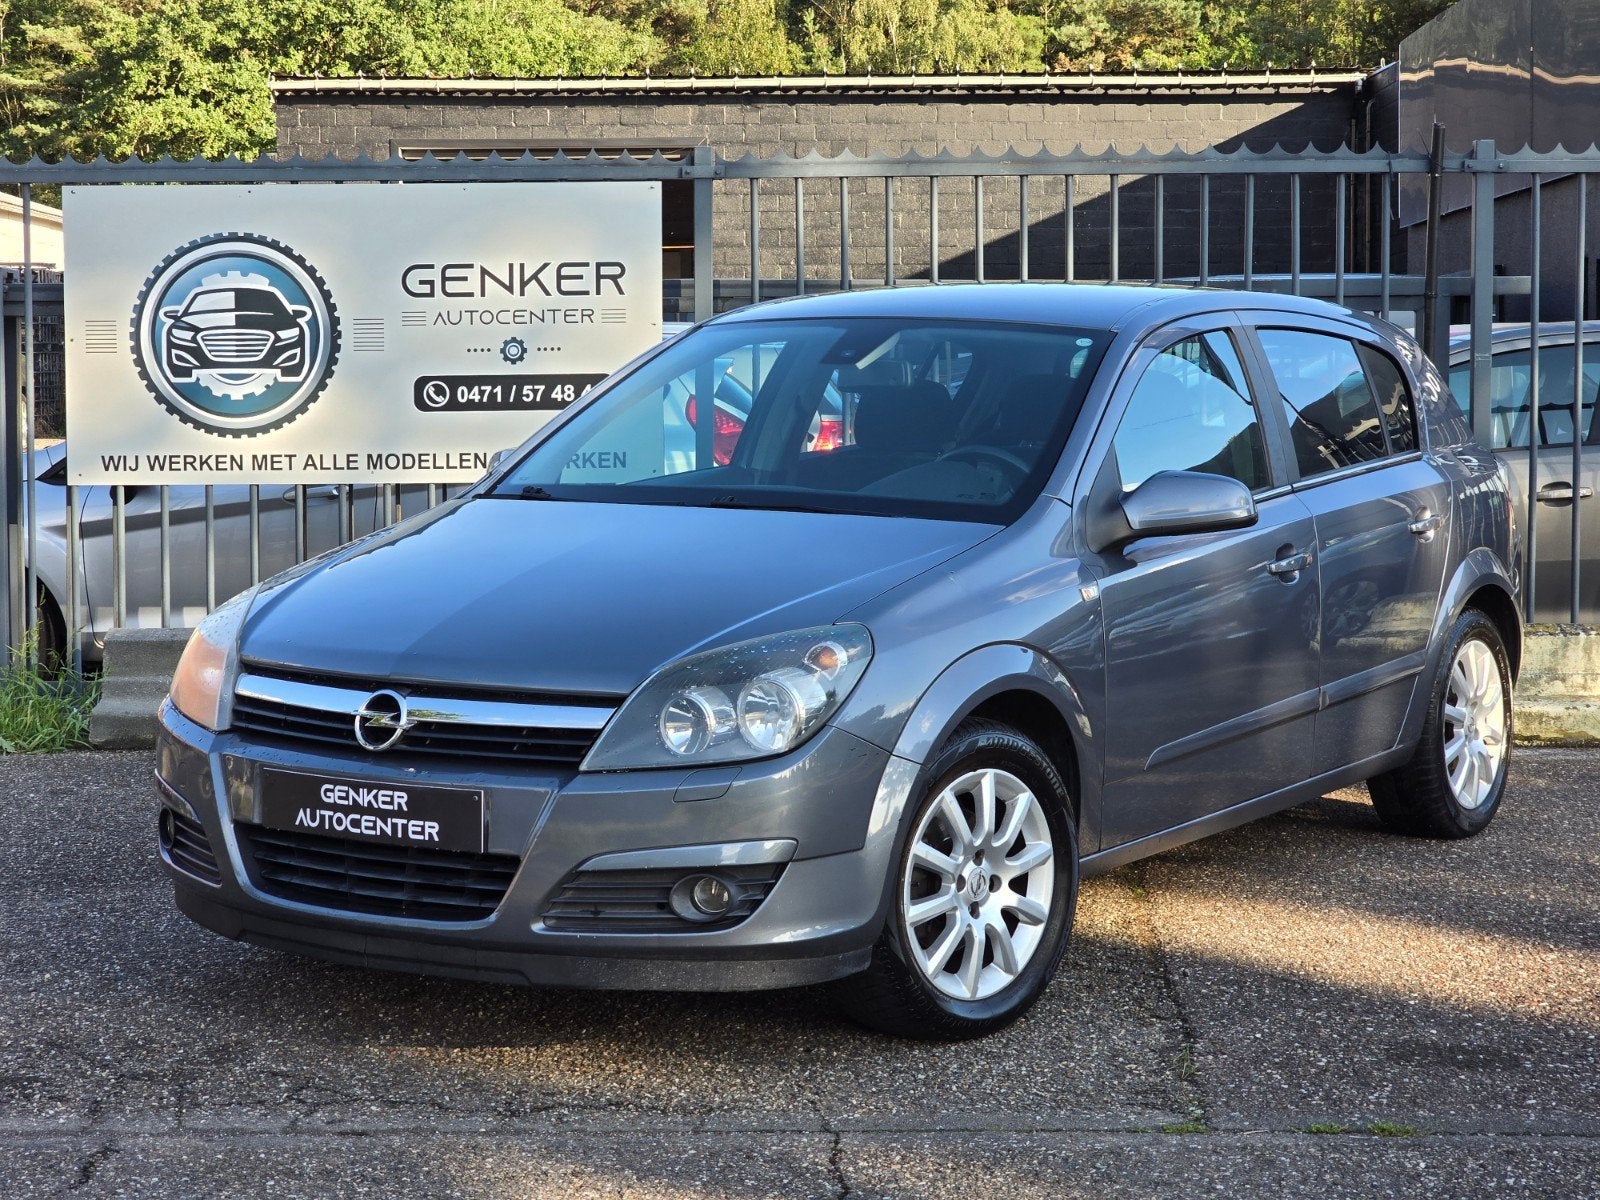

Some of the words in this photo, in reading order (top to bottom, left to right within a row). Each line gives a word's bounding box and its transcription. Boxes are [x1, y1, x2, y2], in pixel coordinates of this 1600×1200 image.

[401, 261, 626, 298] GENKER
[433, 308, 594, 326] AUTOCENTER
[456, 385, 502, 403] 0471
[522, 384, 545, 402] 57
[551, 383, 575, 402] 48
[101, 455, 139, 471] WIJ
[146, 454, 243, 471] WERKEN
[252, 454, 297, 471] MET
[302, 453, 359, 470] ALLE
[367, 452, 487, 470] MODELLEN
[320, 783, 408, 811] GENKER
[295, 807, 440, 842] AUTOCENTER
